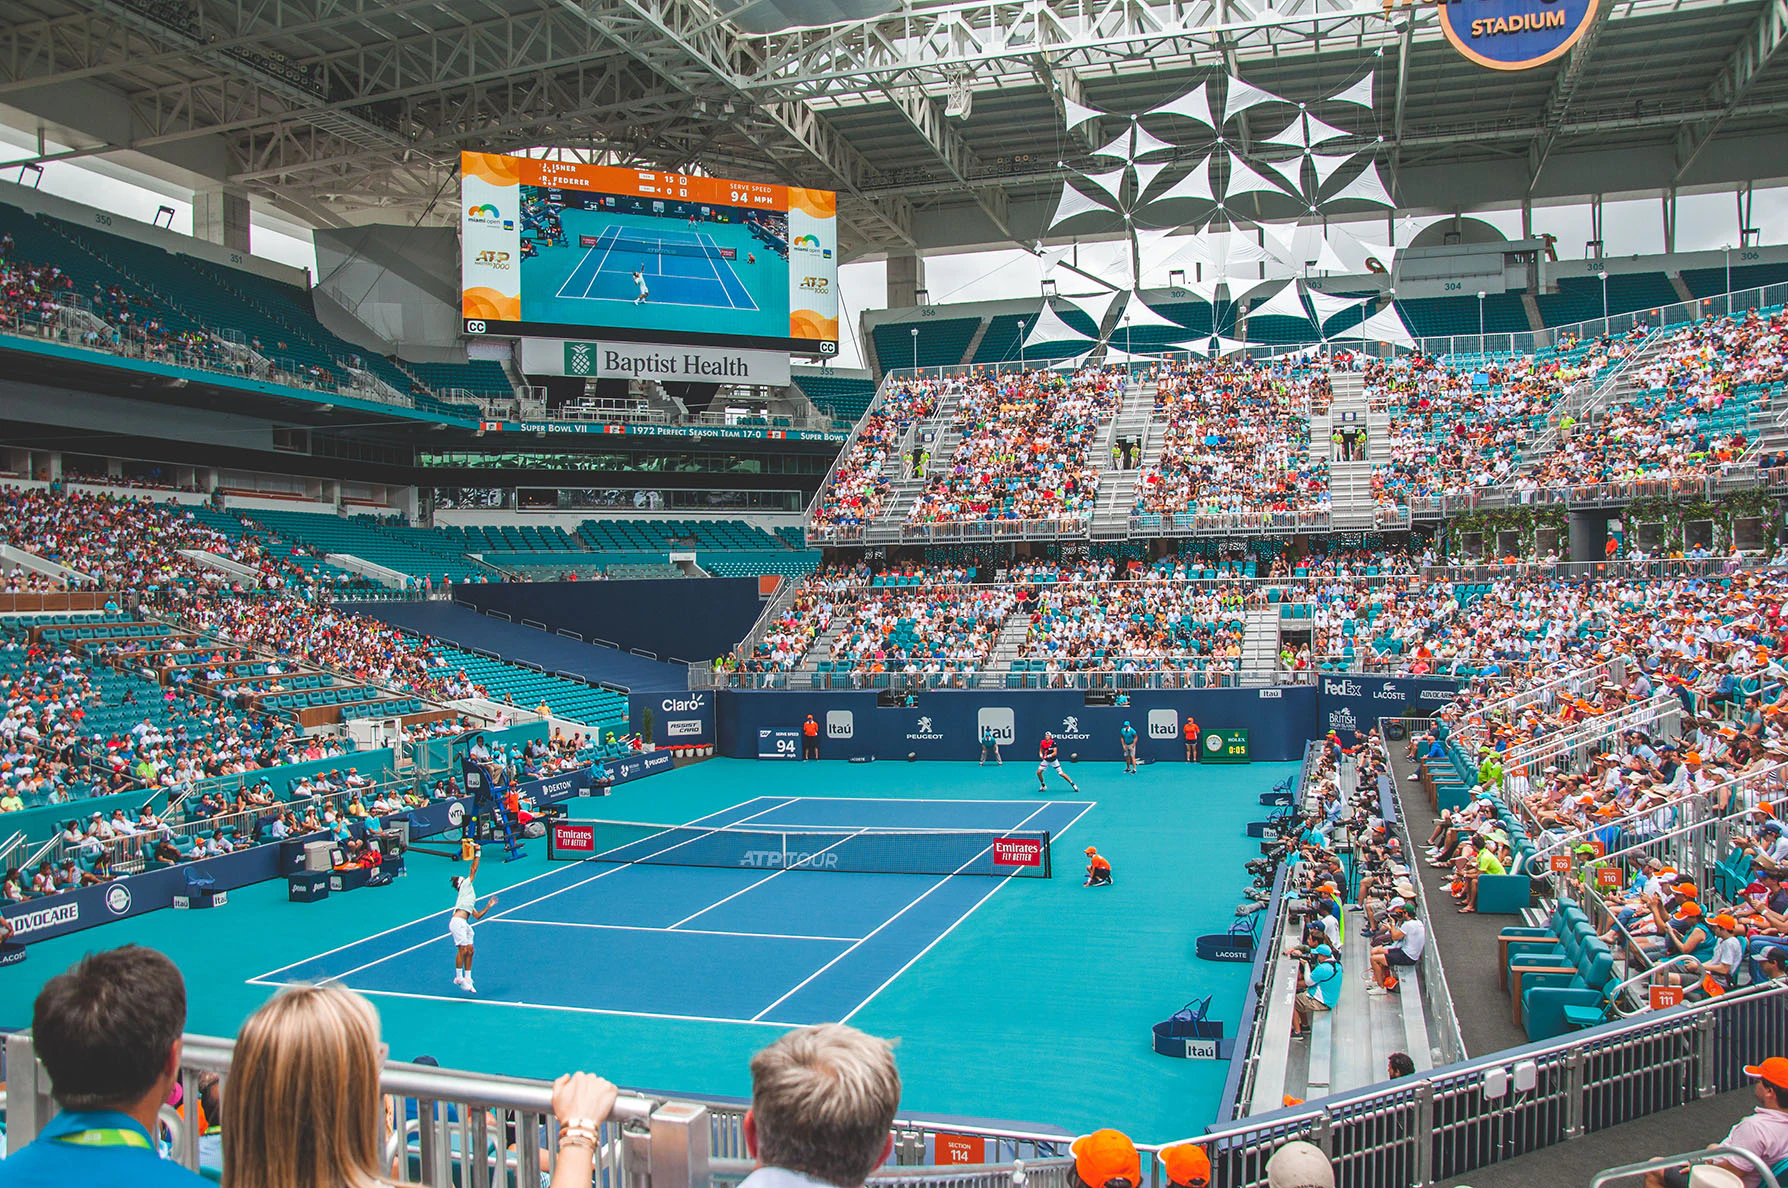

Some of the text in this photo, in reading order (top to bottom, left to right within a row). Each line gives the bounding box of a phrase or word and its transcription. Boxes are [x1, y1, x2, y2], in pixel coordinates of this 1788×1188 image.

[1471, 10, 1566, 36] STADIUM
[552, 164, 576, 173] ISNER
[553, 177, 590, 186] FEDERER
[730, 183, 749, 191] SERVE
[731, 191, 773, 204] 94 MPH
[95, 213, 112, 226] 350
[230, 253, 243, 264] 351
[476, 250, 510, 262] ATP
[1740, 252, 1759, 260] 306
[493, 262, 510, 270] 1000
[1586, 263, 1605, 271] 305
[801, 276, 828, 288] ATP
[1444, 282, 1462, 291] 304
[1171, 291, 1185, 299] 302
[921, 309, 936, 317] 356
[469, 322, 485, 332] CC
[821, 343, 835, 353] CC
[604, 350, 749, 377] Baptist Health
[819, 368, 834, 376] 355
[521, 423, 587, 433] SUPER BOWL VII
[632, 426, 762, 438] 1972 PERFECT SEASON TEAM 17-0
[800, 432, 822, 441] SUPER
[824, 433, 845, 441] BOWL
[1325, 679, 1361, 697] FedEx
[1373, 691, 1406, 700] LACOSTE
[662, 696, 699, 712] Claro
[1329, 712, 1356, 724] BRITISH
[828, 723, 852, 734] Itaú
[1150, 723, 1176, 734] Itaú
[776, 740, 796, 752] 94
[1228, 745, 1246, 754] 0:05
[649, 755, 669, 766] PEUGEOT
[549, 780, 570, 792] DEKTON
[449, 809, 464, 819] WTA
[557, 829, 592, 839] Emirates
[562, 838, 587, 847] FLY BETTER
[996, 842, 1038, 853] Emirates
[740, 850, 838, 868] ATP TOUR
[1002, 852, 1032, 861] FLY BETTER
[175, 899, 188, 907] Itaú
[1215, 951, 1247, 959] LACOSTE
[1659, 996, 1674, 1006] 111
[1188, 1045, 1214, 1057] Itaú
[948, 1141, 971, 1150] SECTION
[951, 1149, 969, 1162] 114
